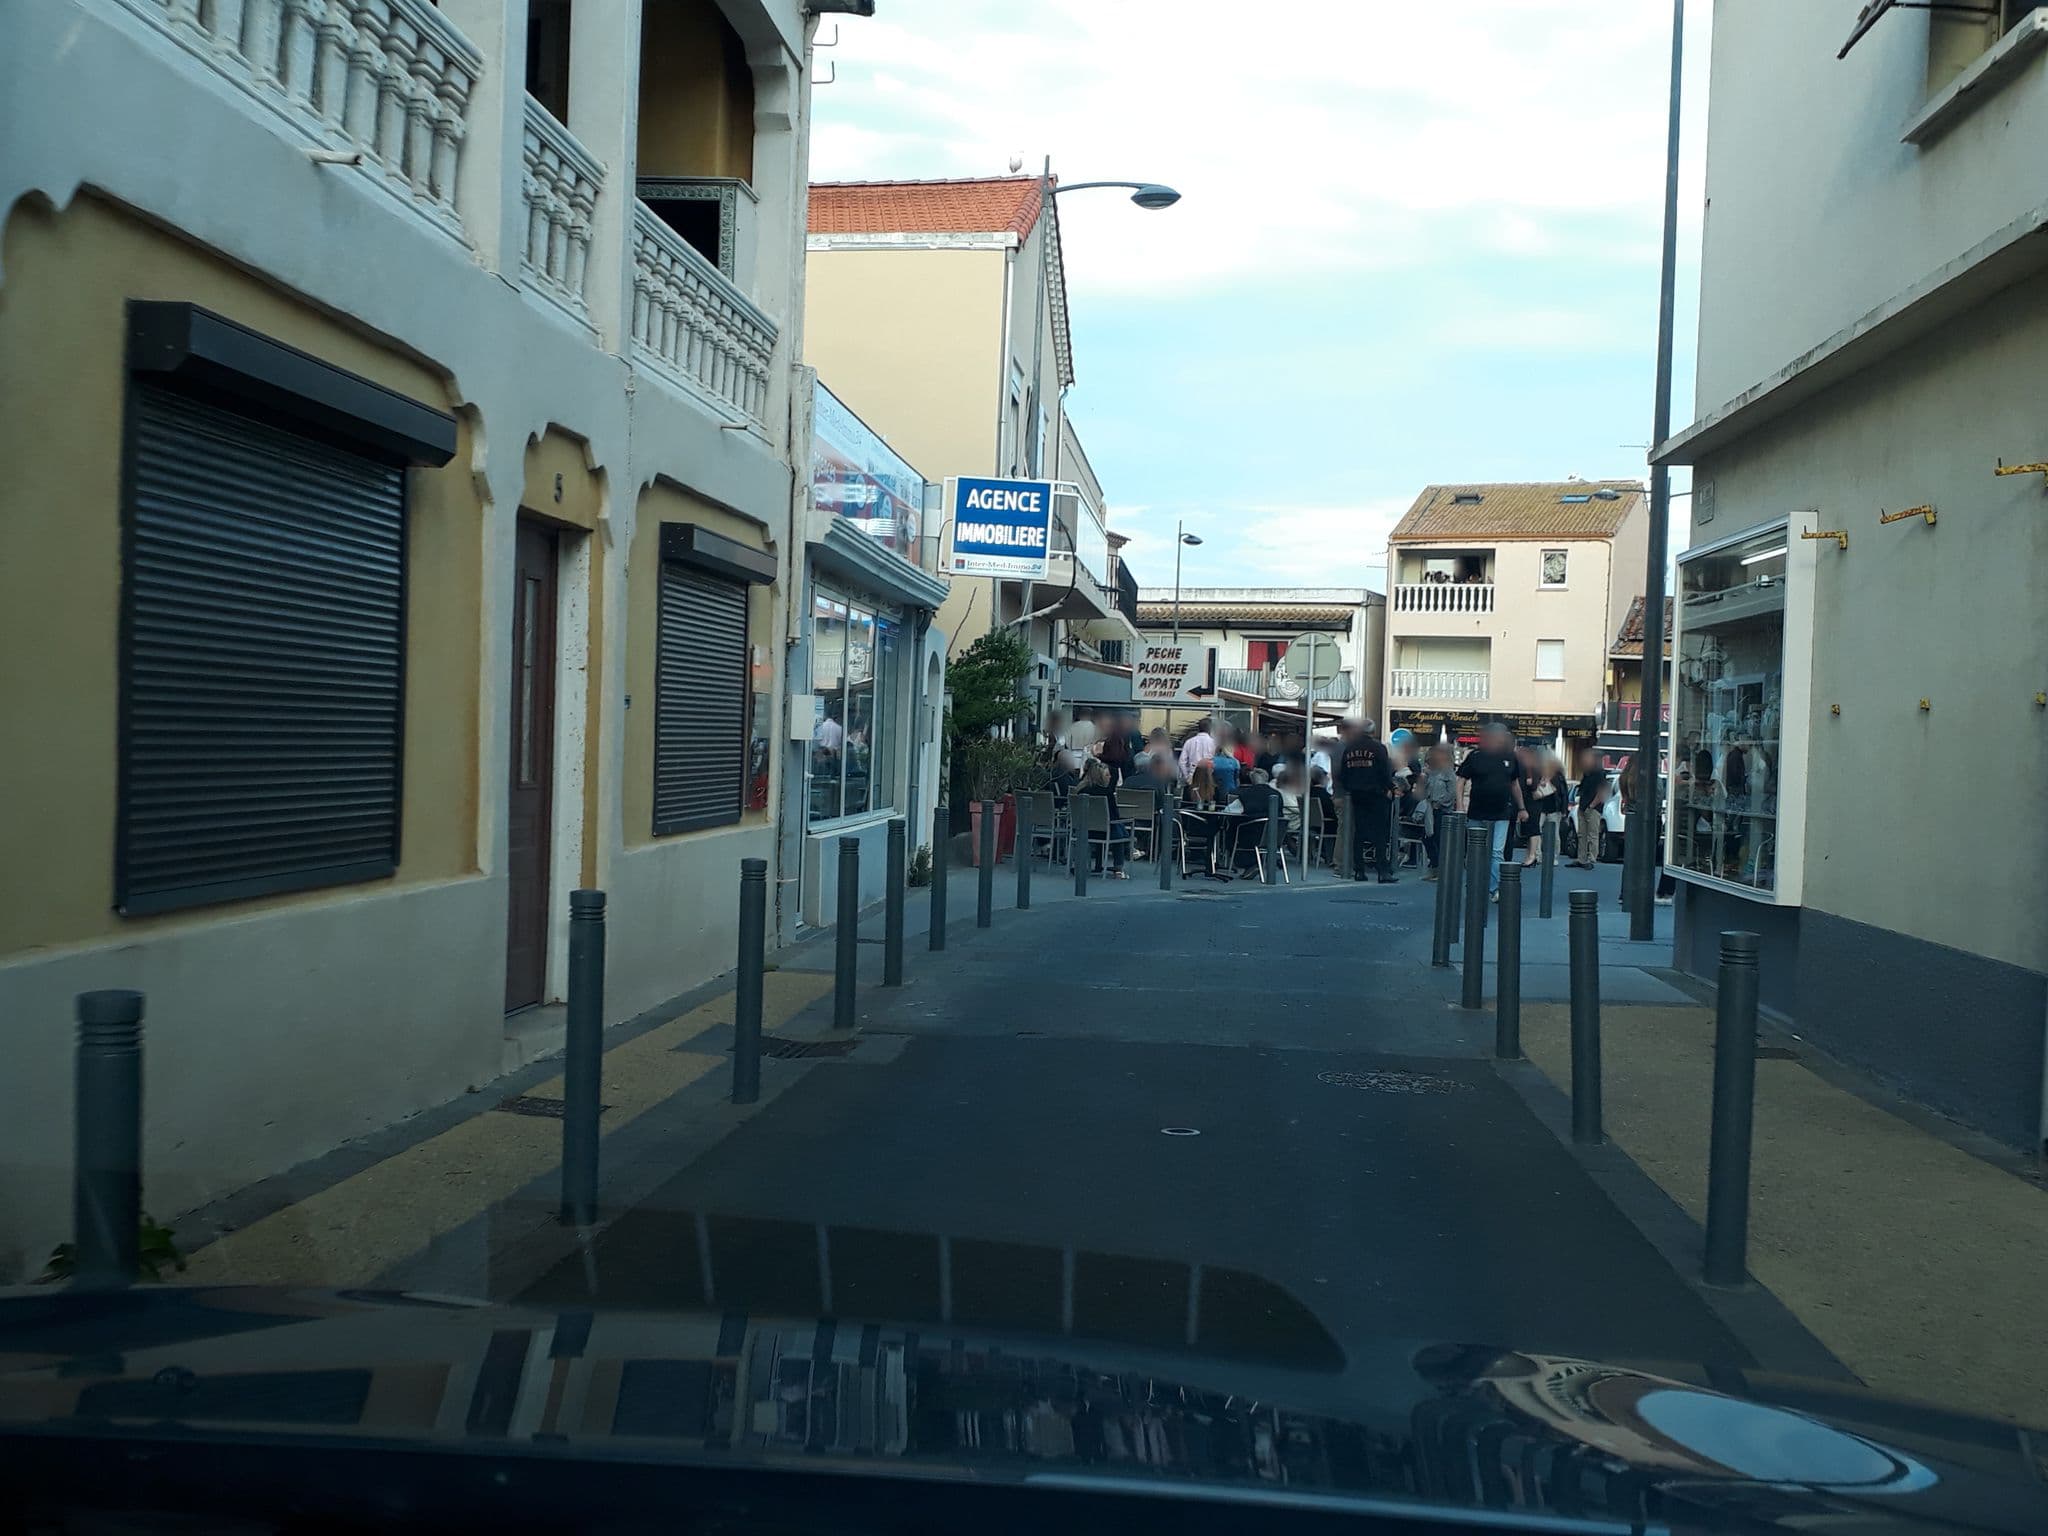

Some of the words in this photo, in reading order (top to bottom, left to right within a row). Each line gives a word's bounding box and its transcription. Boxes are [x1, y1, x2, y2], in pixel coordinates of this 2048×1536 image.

[966, 488, 1041, 512] AGENCE
[957, 522, 1045, 547] IMMOBILIERE
[1146, 647, 1182, 659] PECHE
[1138, 662, 1188, 675] PLONGEE
[1139, 678, 1182, 690] APPATS
